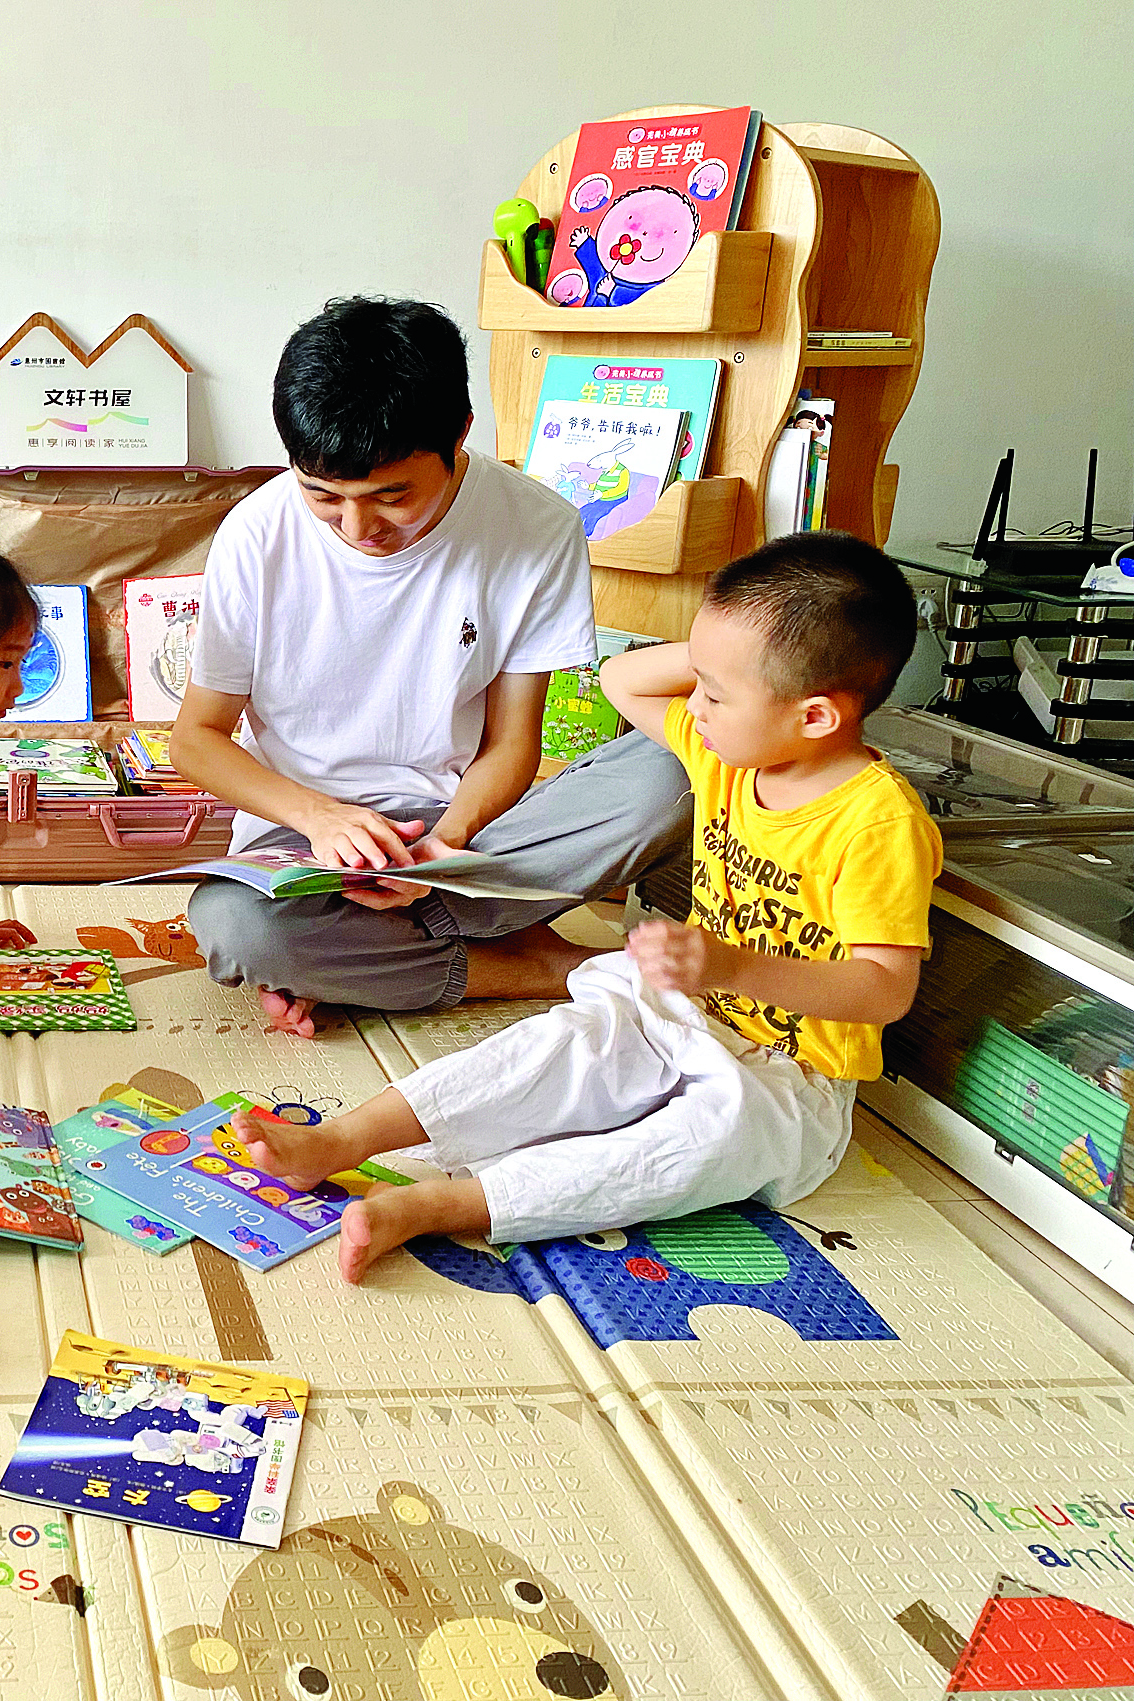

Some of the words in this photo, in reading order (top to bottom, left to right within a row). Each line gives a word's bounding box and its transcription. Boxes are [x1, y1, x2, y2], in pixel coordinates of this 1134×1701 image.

[610, 140, 706, 170] 感官宝典
[43, 388, 132, 407] 文轩书屋
[578, 381, 670, 408] 生活宝典
[161, 598, 200, 618] 曹冲
[798, 921, 834, 951] OF
[171, 1175, 265, 1226] Children's
[173, 1192, 208, 1218] The
[82, 1478, 151, 1506] 太空
